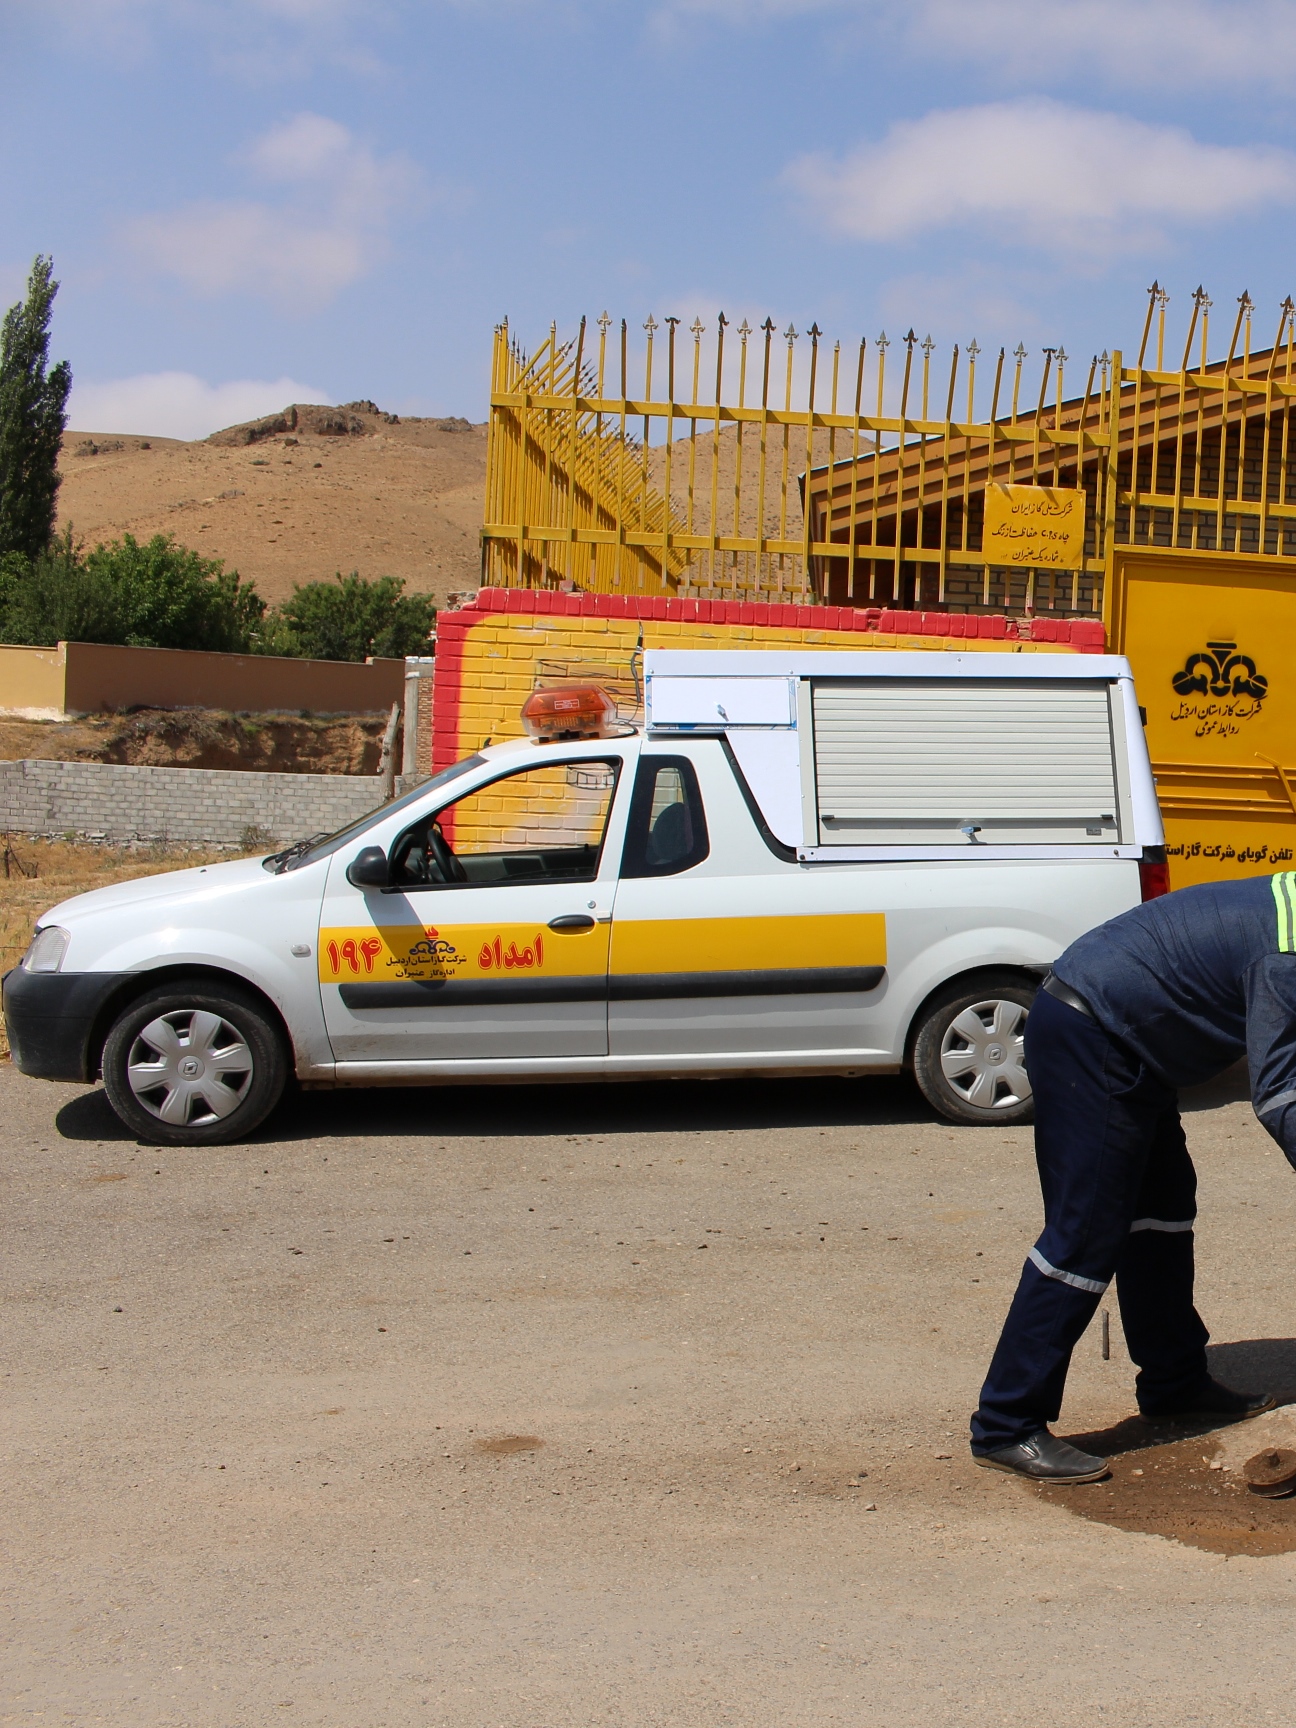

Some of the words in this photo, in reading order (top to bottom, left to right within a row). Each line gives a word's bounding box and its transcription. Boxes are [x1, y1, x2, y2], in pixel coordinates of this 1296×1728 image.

[1170, 701, 1198, 721] اردبیل
[1197, 703, 1221, 720] استان
[1195, 720, 1218, 737] عمومی
[1217, 722, 1240, 738] روابط
[1184, 842, 1201, 860] گاز
[1202, 844, 1236, 862] شرکت
[1237, 845, 1268, 863] گویای
[1269, 848, 1294, 864] تلفن
[326, 936, 383, 975] ۱۹۴
[446, 954, 468, 965] شرکت
[478, 933, 545, 970] امداد
